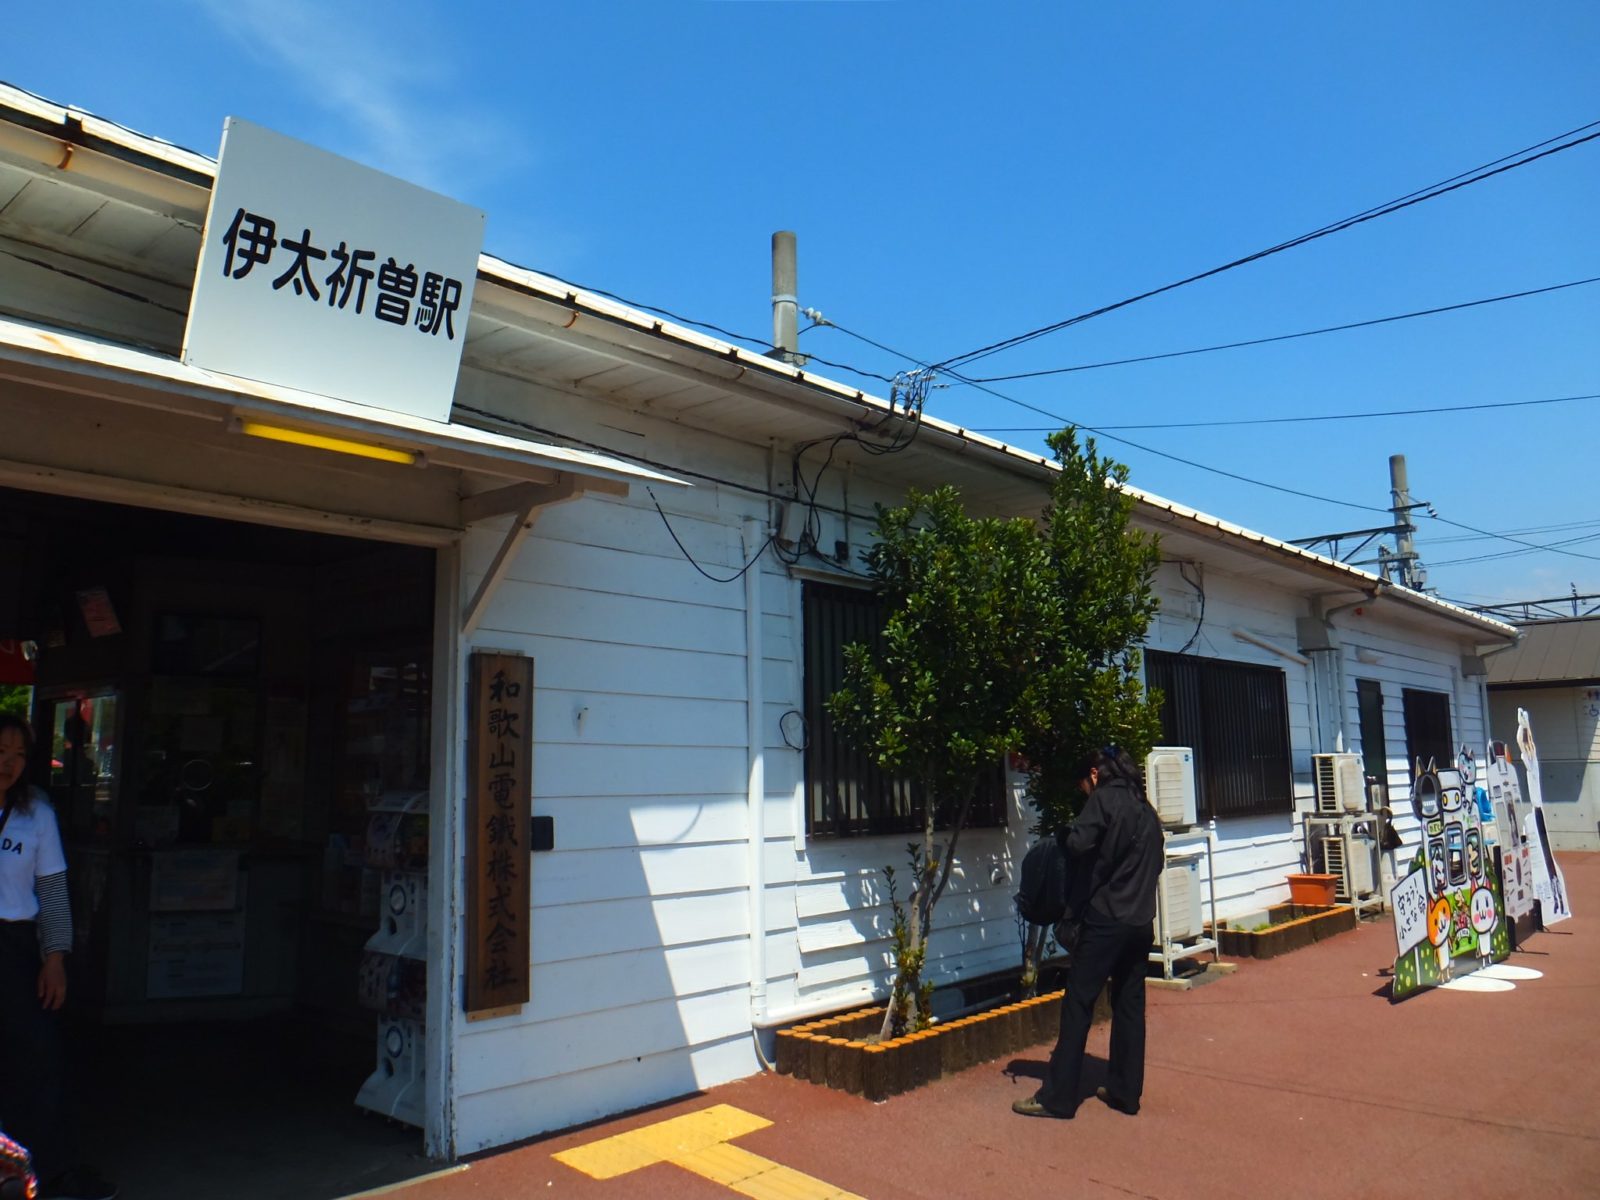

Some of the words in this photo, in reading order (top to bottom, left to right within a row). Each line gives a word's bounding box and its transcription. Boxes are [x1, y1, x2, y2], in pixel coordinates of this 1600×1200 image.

[223, 208, 462, 340] 伊太祈曽駅
